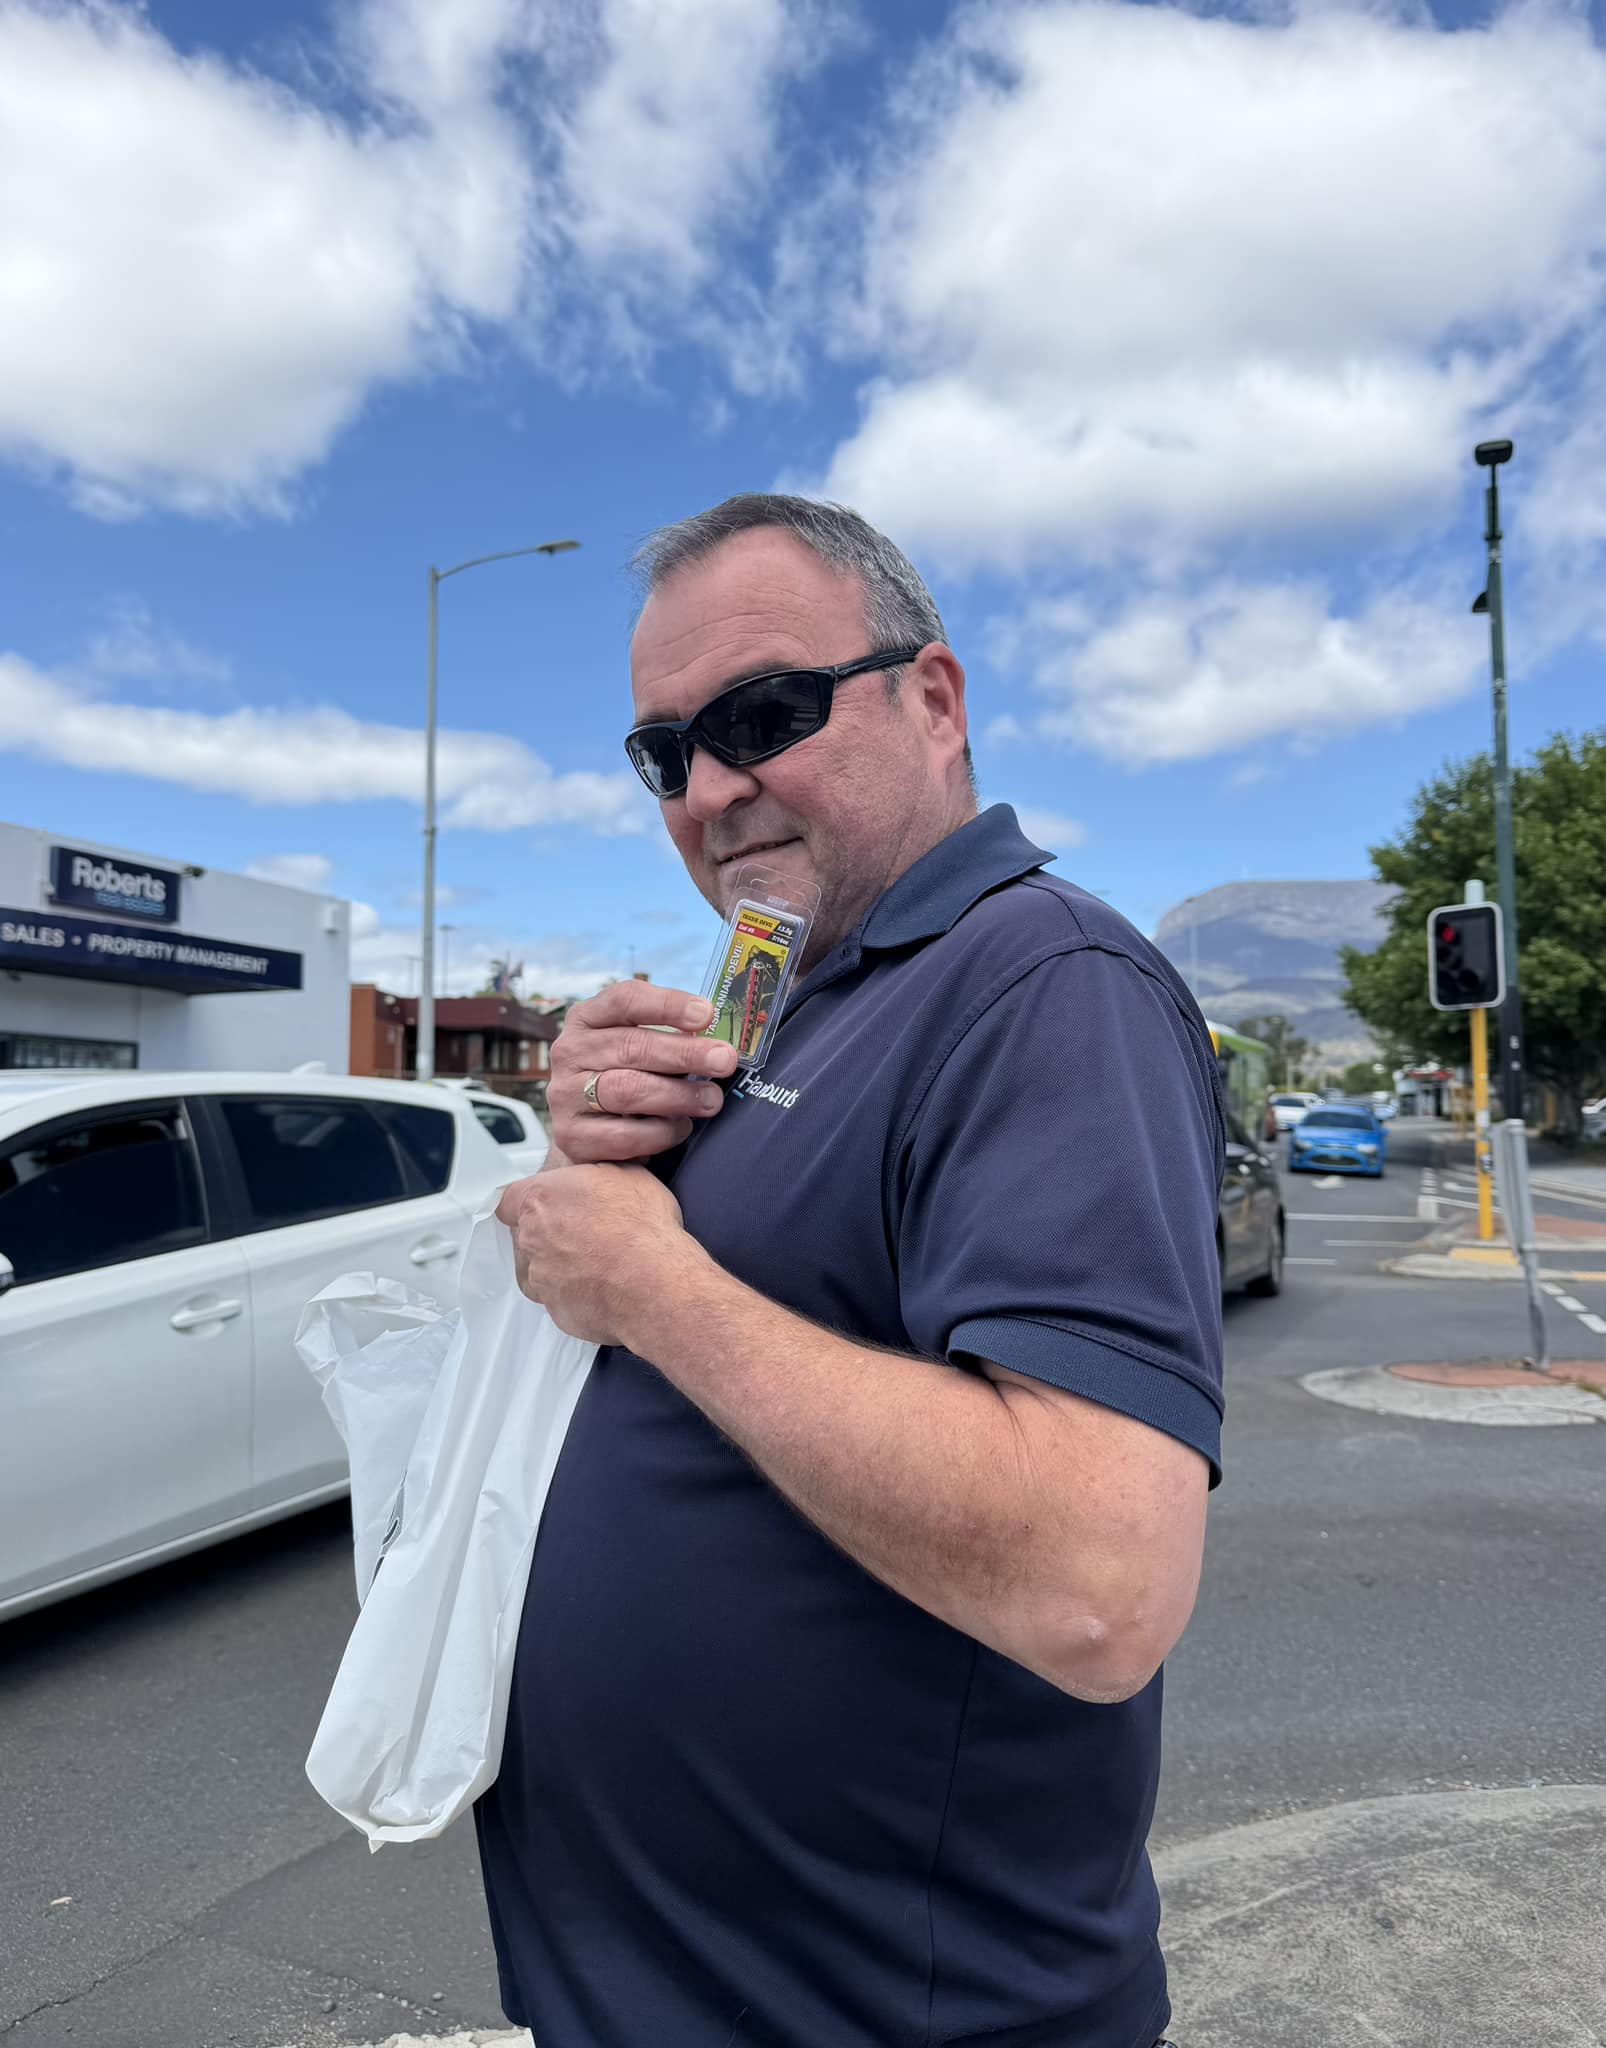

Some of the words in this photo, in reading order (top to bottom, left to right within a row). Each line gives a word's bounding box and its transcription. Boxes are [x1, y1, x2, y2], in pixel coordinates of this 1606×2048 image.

[72, 856, 166, 902] Roberts
[1, 922, 65, 948] SALES
[88, 933, 174, 961] PROPERTY
[175, 945, 269, 975] MANAGEMENT
[705, 976, 733, 1036] TASMANIAN
[728, 943, 744, 975] DEVIL
